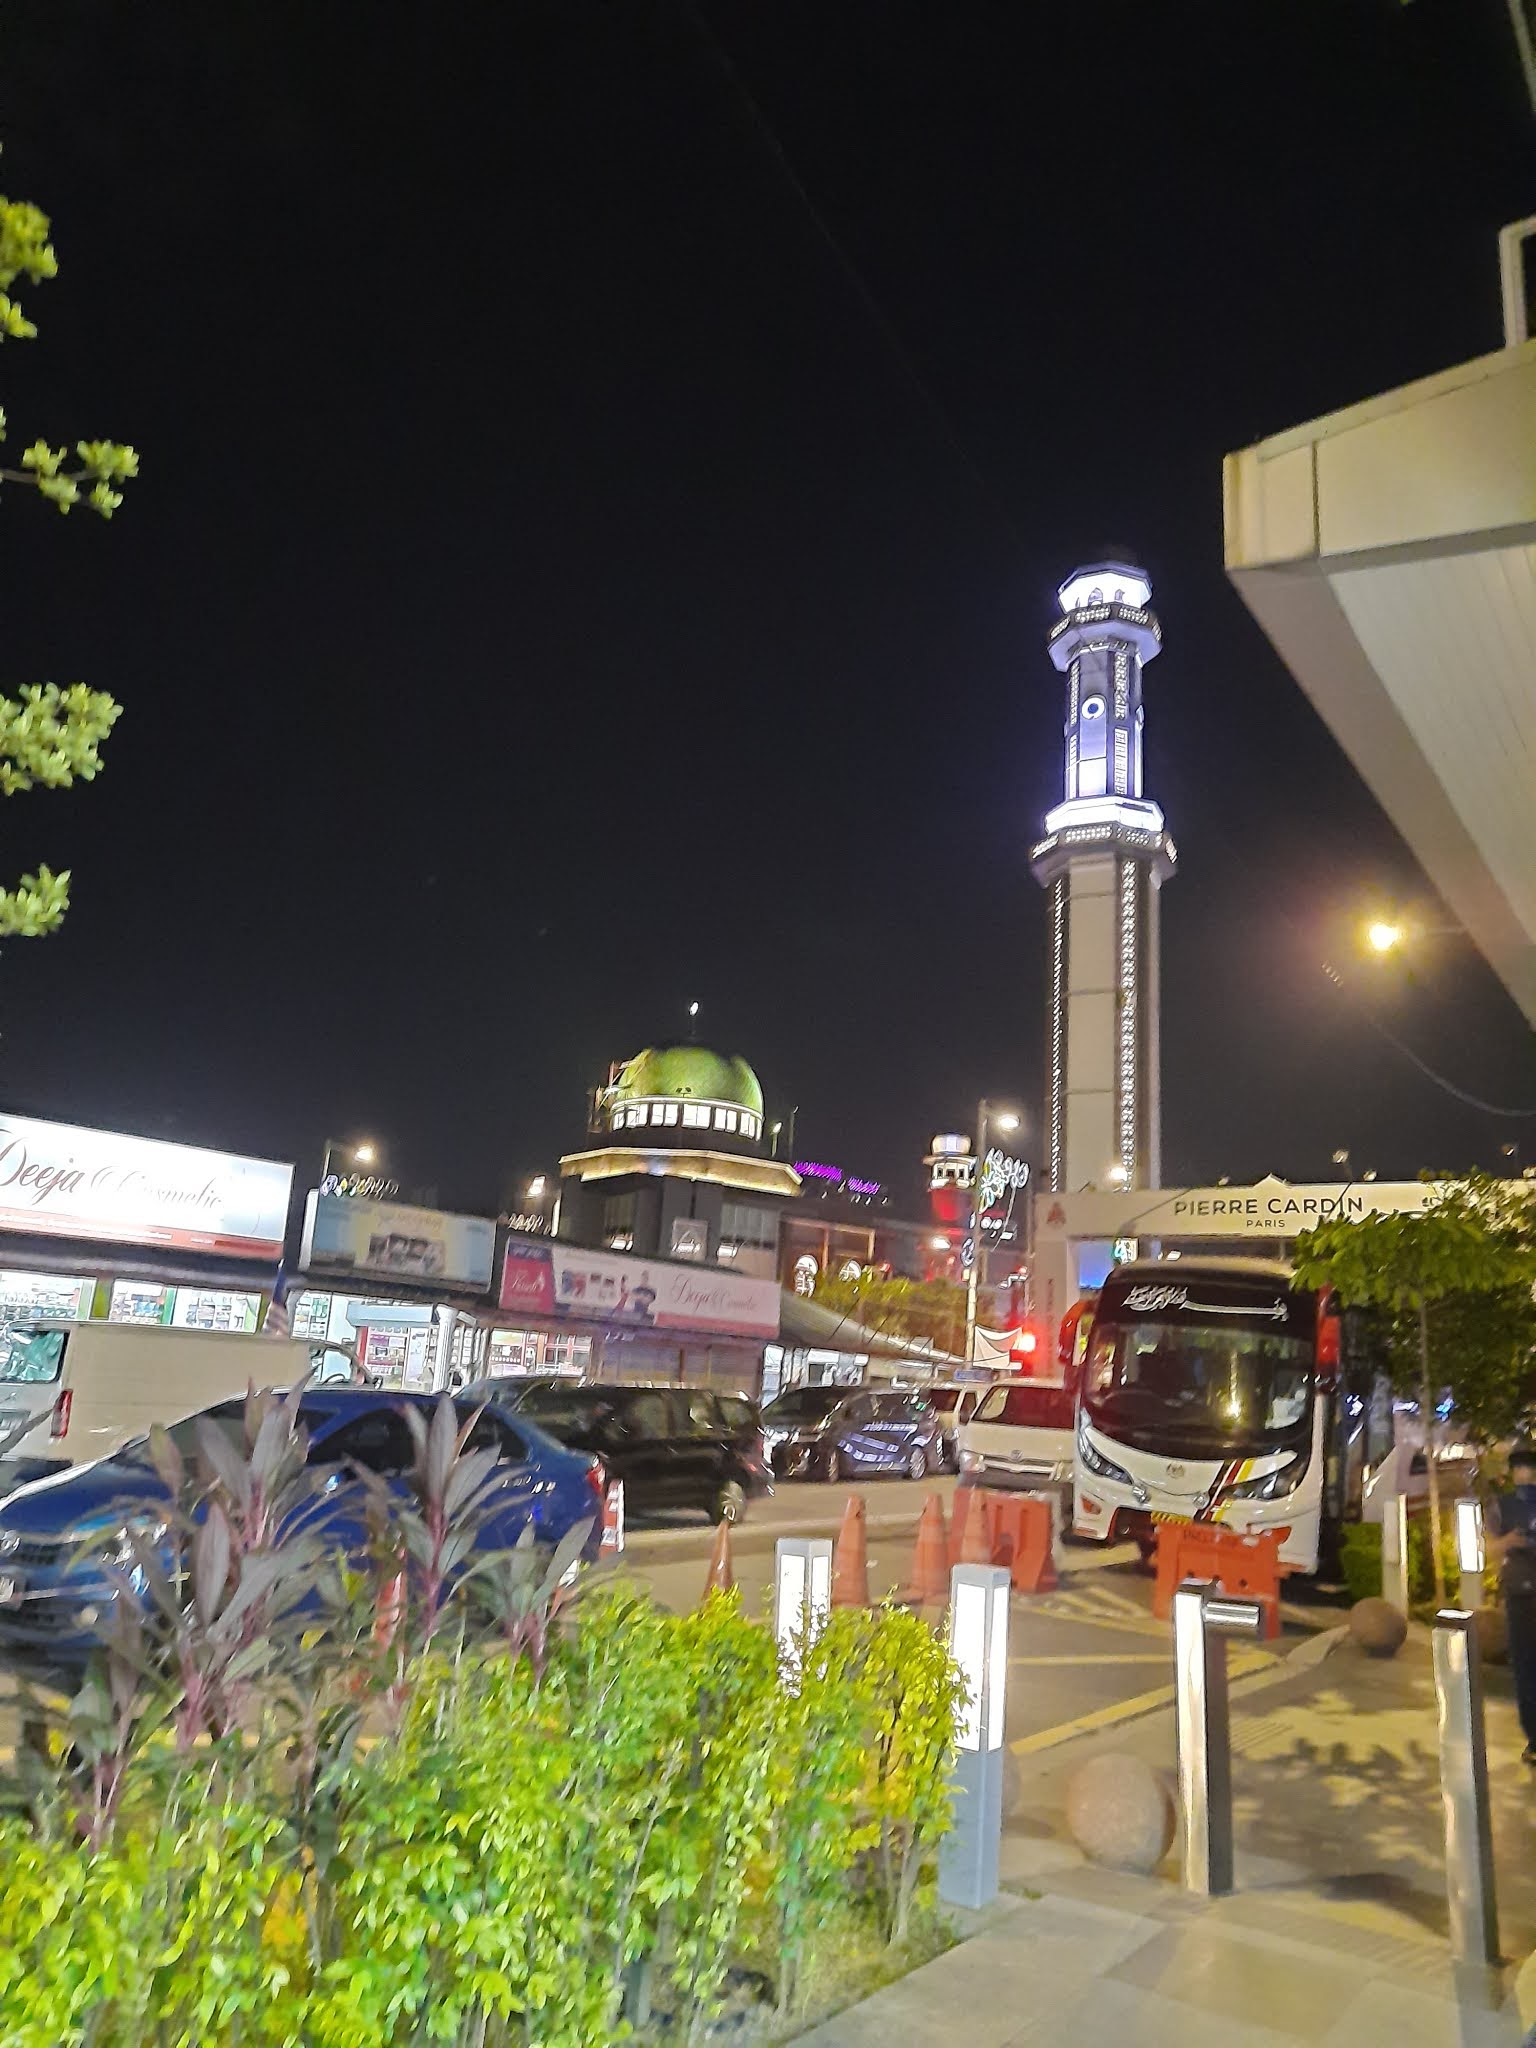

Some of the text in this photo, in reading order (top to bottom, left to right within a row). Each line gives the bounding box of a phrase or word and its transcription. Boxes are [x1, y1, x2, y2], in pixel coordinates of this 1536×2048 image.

[0, 1129, 222, 1209] Deeja Csmetic
[1174, 1196, 1364, 1216] PIERRE CARDIN
[1246, 1219, 1286, 1228] PARIS
